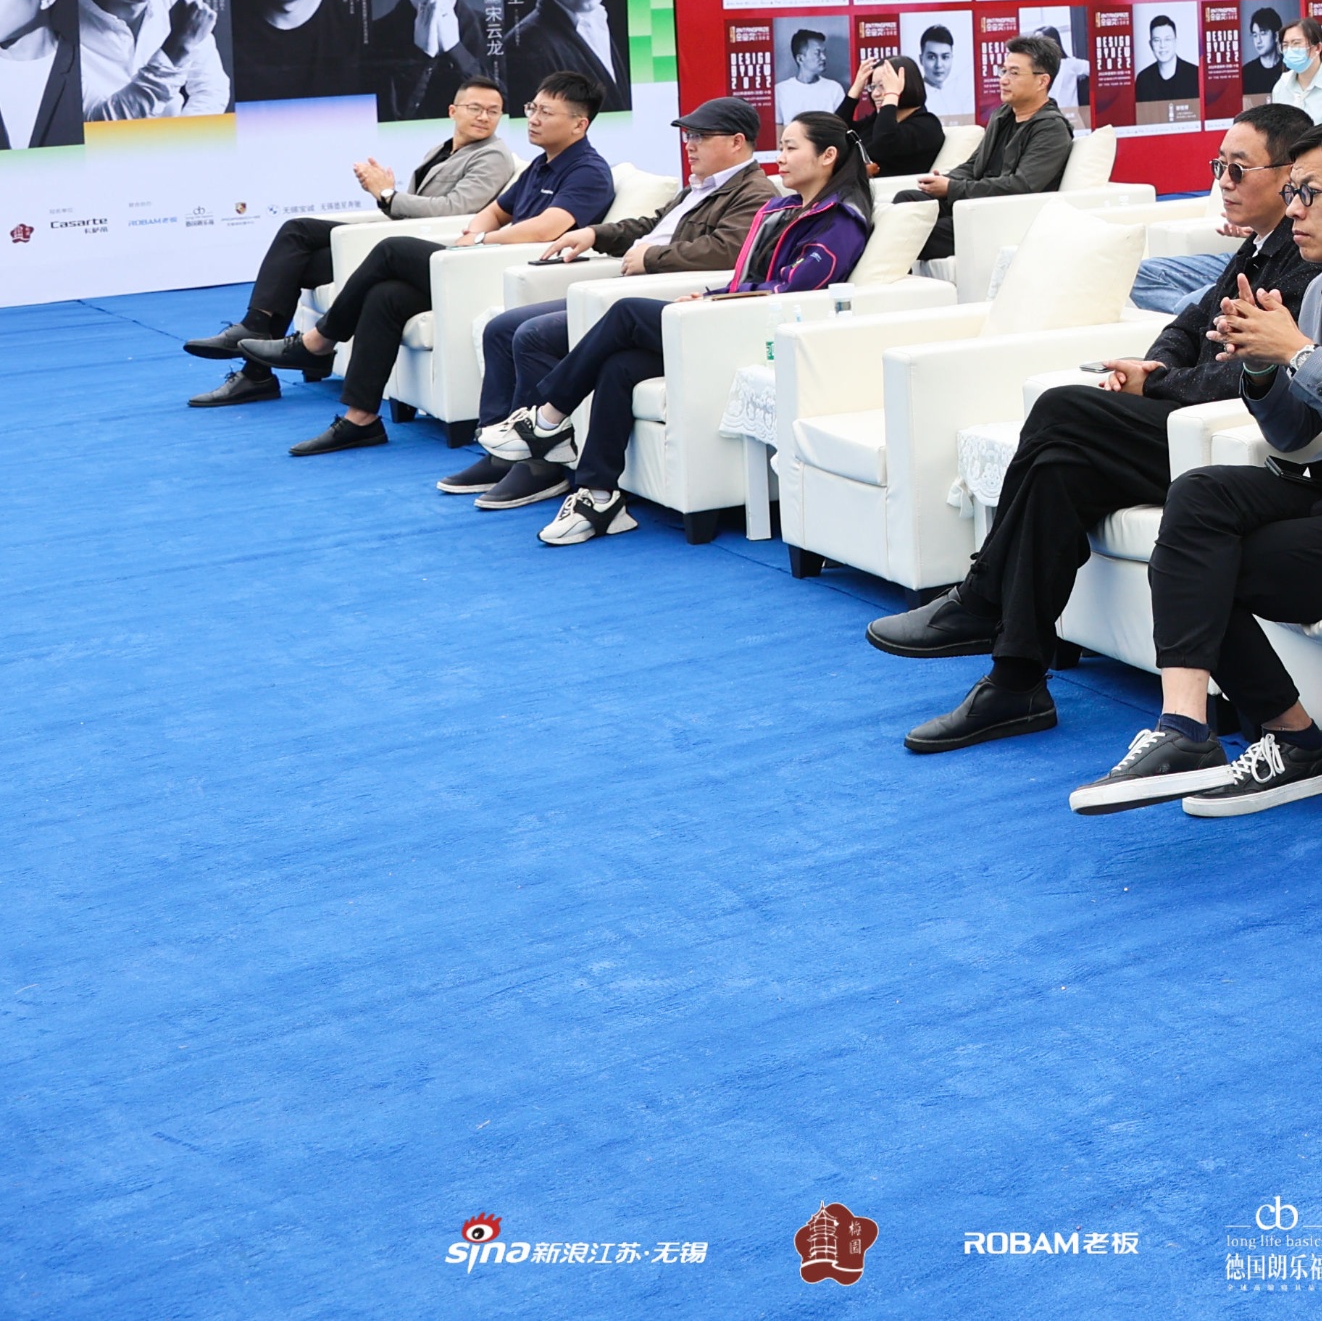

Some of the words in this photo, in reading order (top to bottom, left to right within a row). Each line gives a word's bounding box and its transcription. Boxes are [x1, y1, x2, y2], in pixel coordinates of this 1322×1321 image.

[485, 6, 504, 56] 宋云龙
[982, 65, 999, 77] 20
